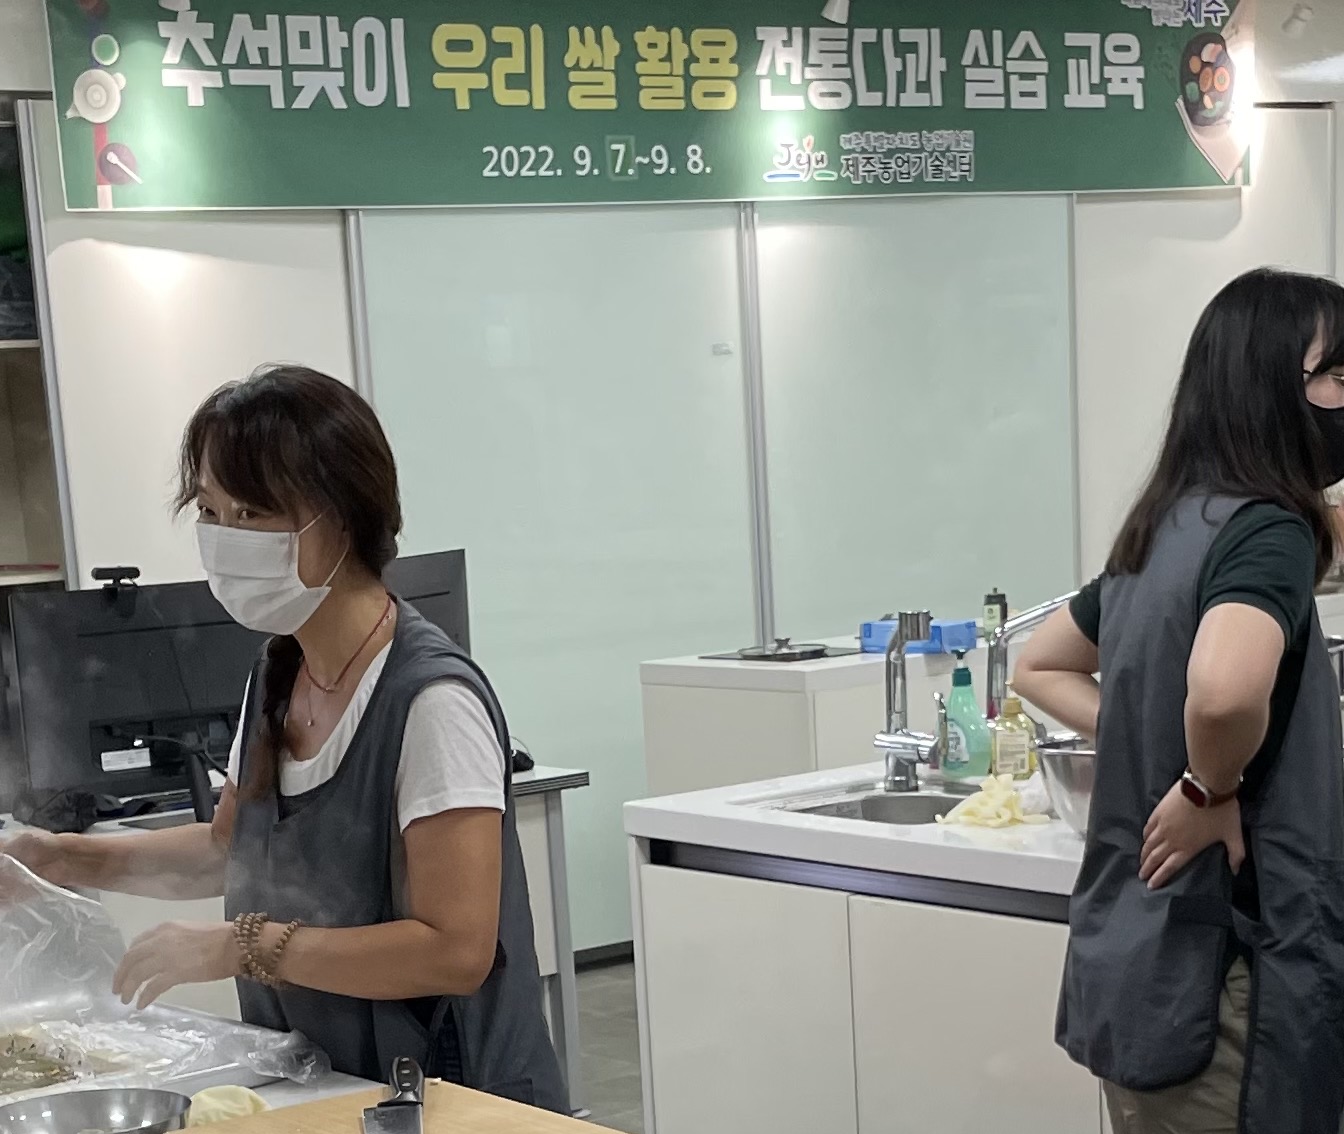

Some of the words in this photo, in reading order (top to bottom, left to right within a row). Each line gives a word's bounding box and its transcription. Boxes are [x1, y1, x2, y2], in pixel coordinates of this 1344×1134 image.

[157, 10, 410, 109] 추석맞이
[431, 23, 546, 110] 우리
[564, 25, 620, 110] 쌀
[633, 26, 738, 110] 활용
[755, 26, 948, 110] 전통다과
[961, 29, 1049, 109] 실습
[1063, 32, 1144, 109] 교육
[482, 145, 562, 177] 2022.
[573, 145, 600, 176] 9.
[686, 144, 712, 174] 8.
[841, 152, 974, 183] 제주농업기술센터
